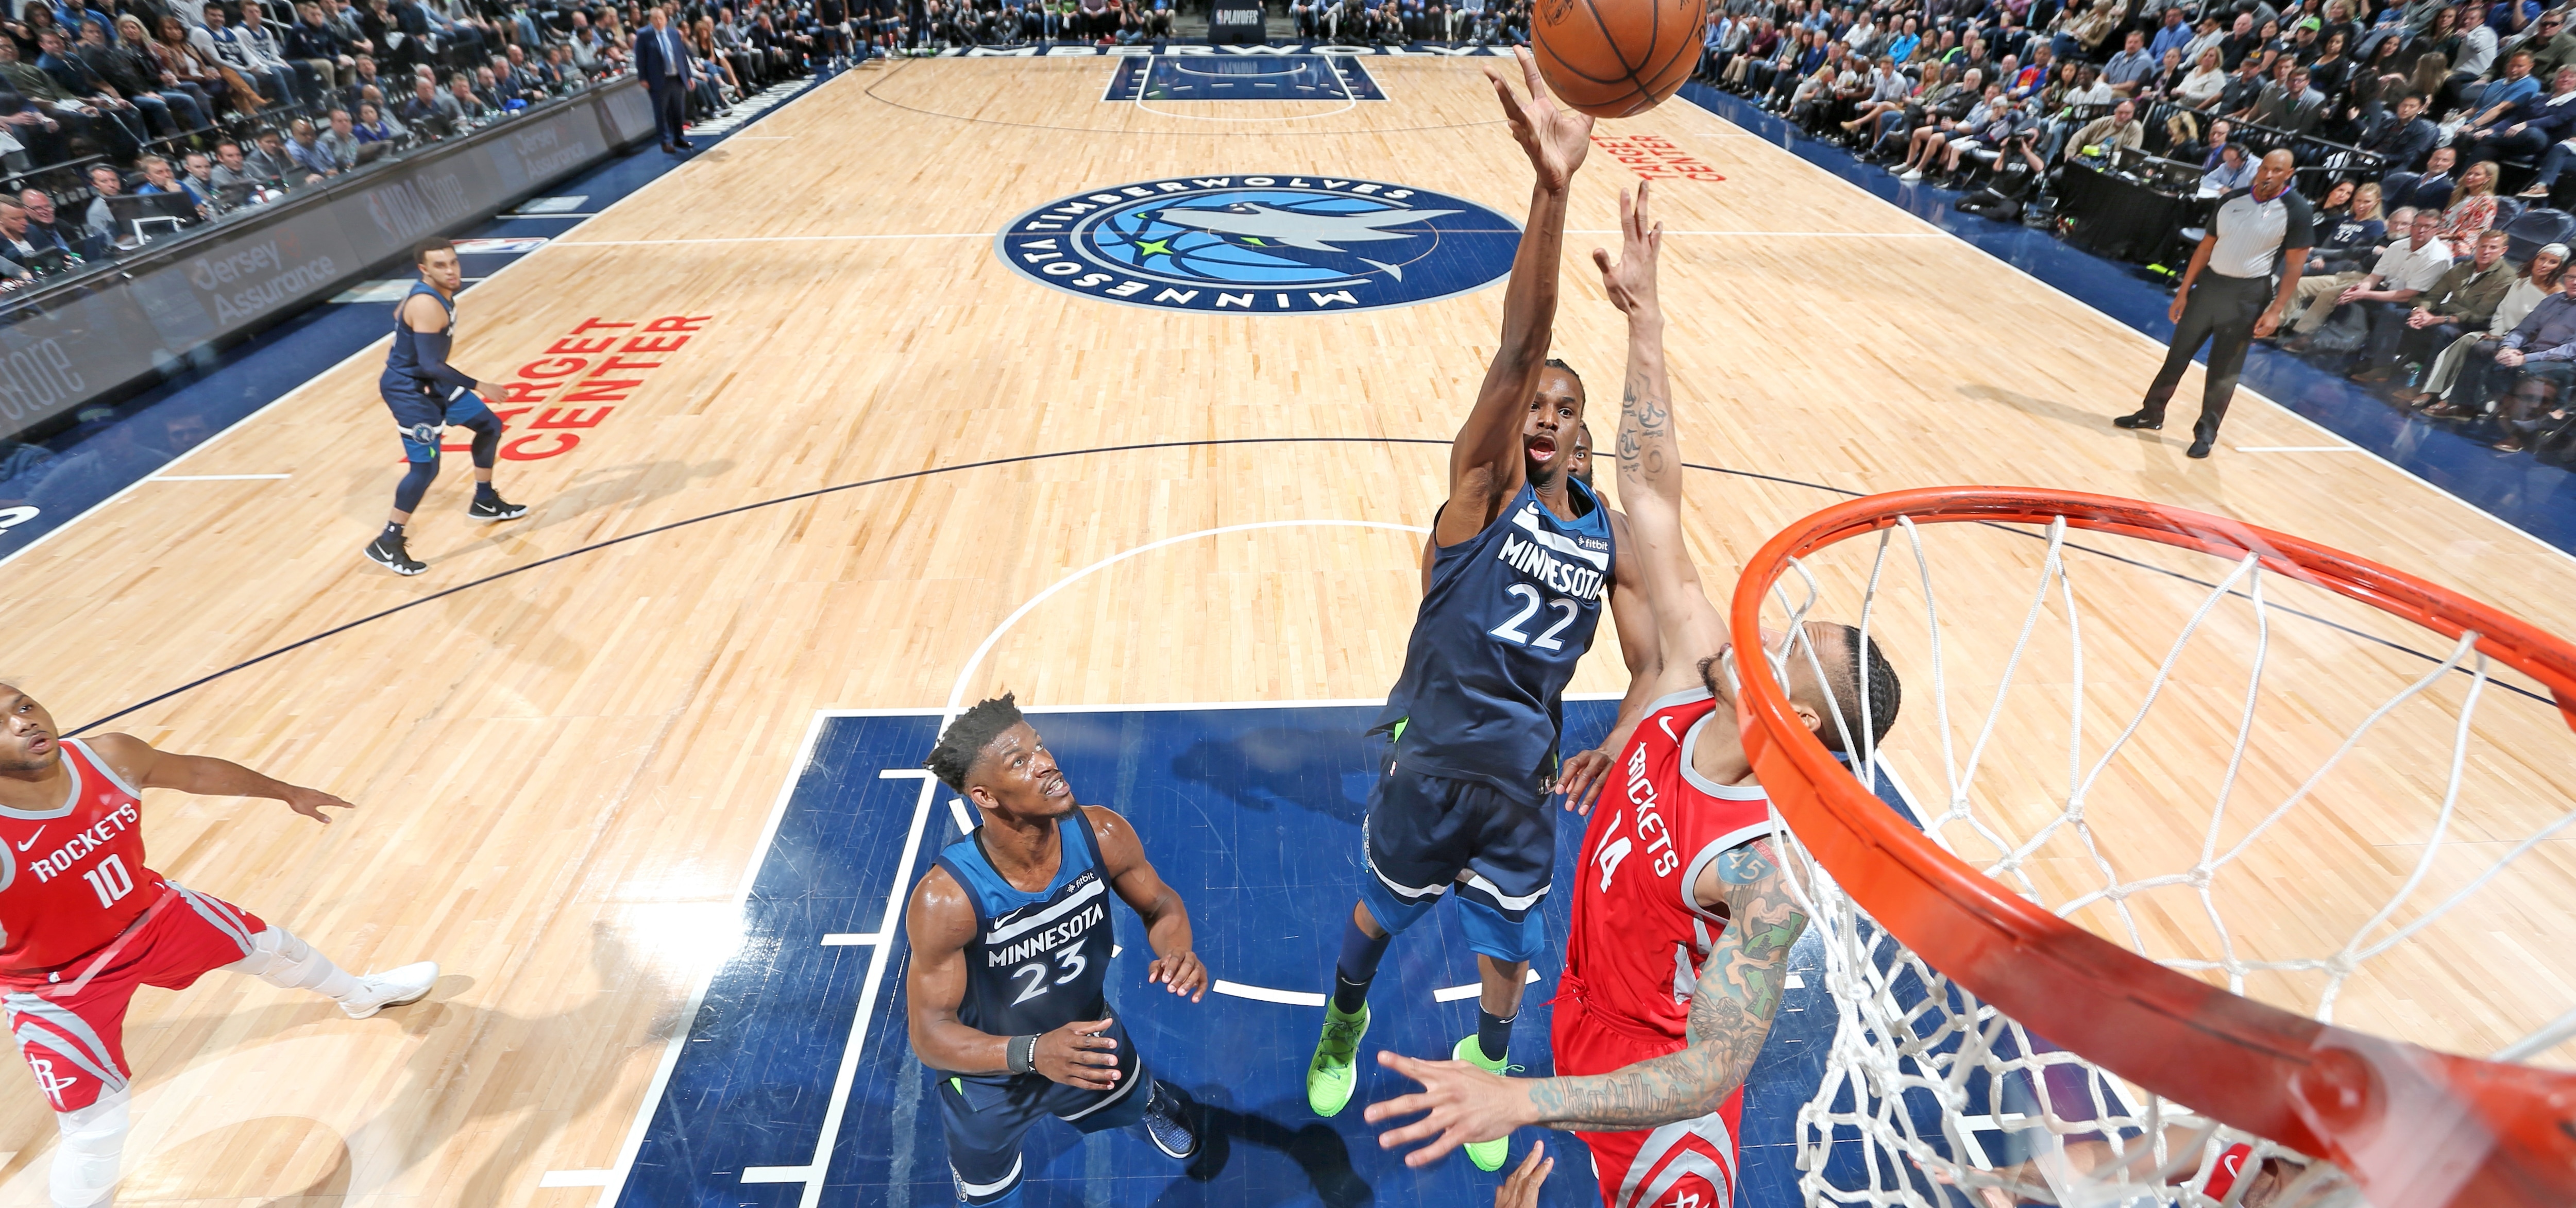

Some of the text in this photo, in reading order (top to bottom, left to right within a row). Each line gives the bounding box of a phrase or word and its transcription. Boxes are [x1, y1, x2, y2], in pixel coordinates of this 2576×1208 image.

[1223, 9, 1259, 25] PLAYOFFS
[898, 45, 1534, 56] IMBERWOLVE
[1590, 135, 1679, 180] TARGET
[1629, 135, 1727, 181] CENTER
[378, 174, 471, 239] NBA Store
[1026, 177, 1414, 230] TIMBERWOLVES
[194, 240, 282, 290] Jersey
[213, 255, 336, 326] Assurance
[1020, 238, 1359, 308] MINNESOTA
[499, 315, 714, 460] CENTER
[1498, 532, 1604, 601] MINNESOTA
[1585, 538, 1608, 550] fitbit
[1487, 581, 1579, 651] 22
[28, 802, 138, 884] ROCKETS
[1590, 809, 1632, 894] 14
[1726, 851, 1766, 880] 45
[82, 853, 134, 910] 10
[1075, 872, 1094, 889] fitbit
[988, 903, 1104, 968] MINNESOTA
[1010, 936, 1088, 1008] 23
